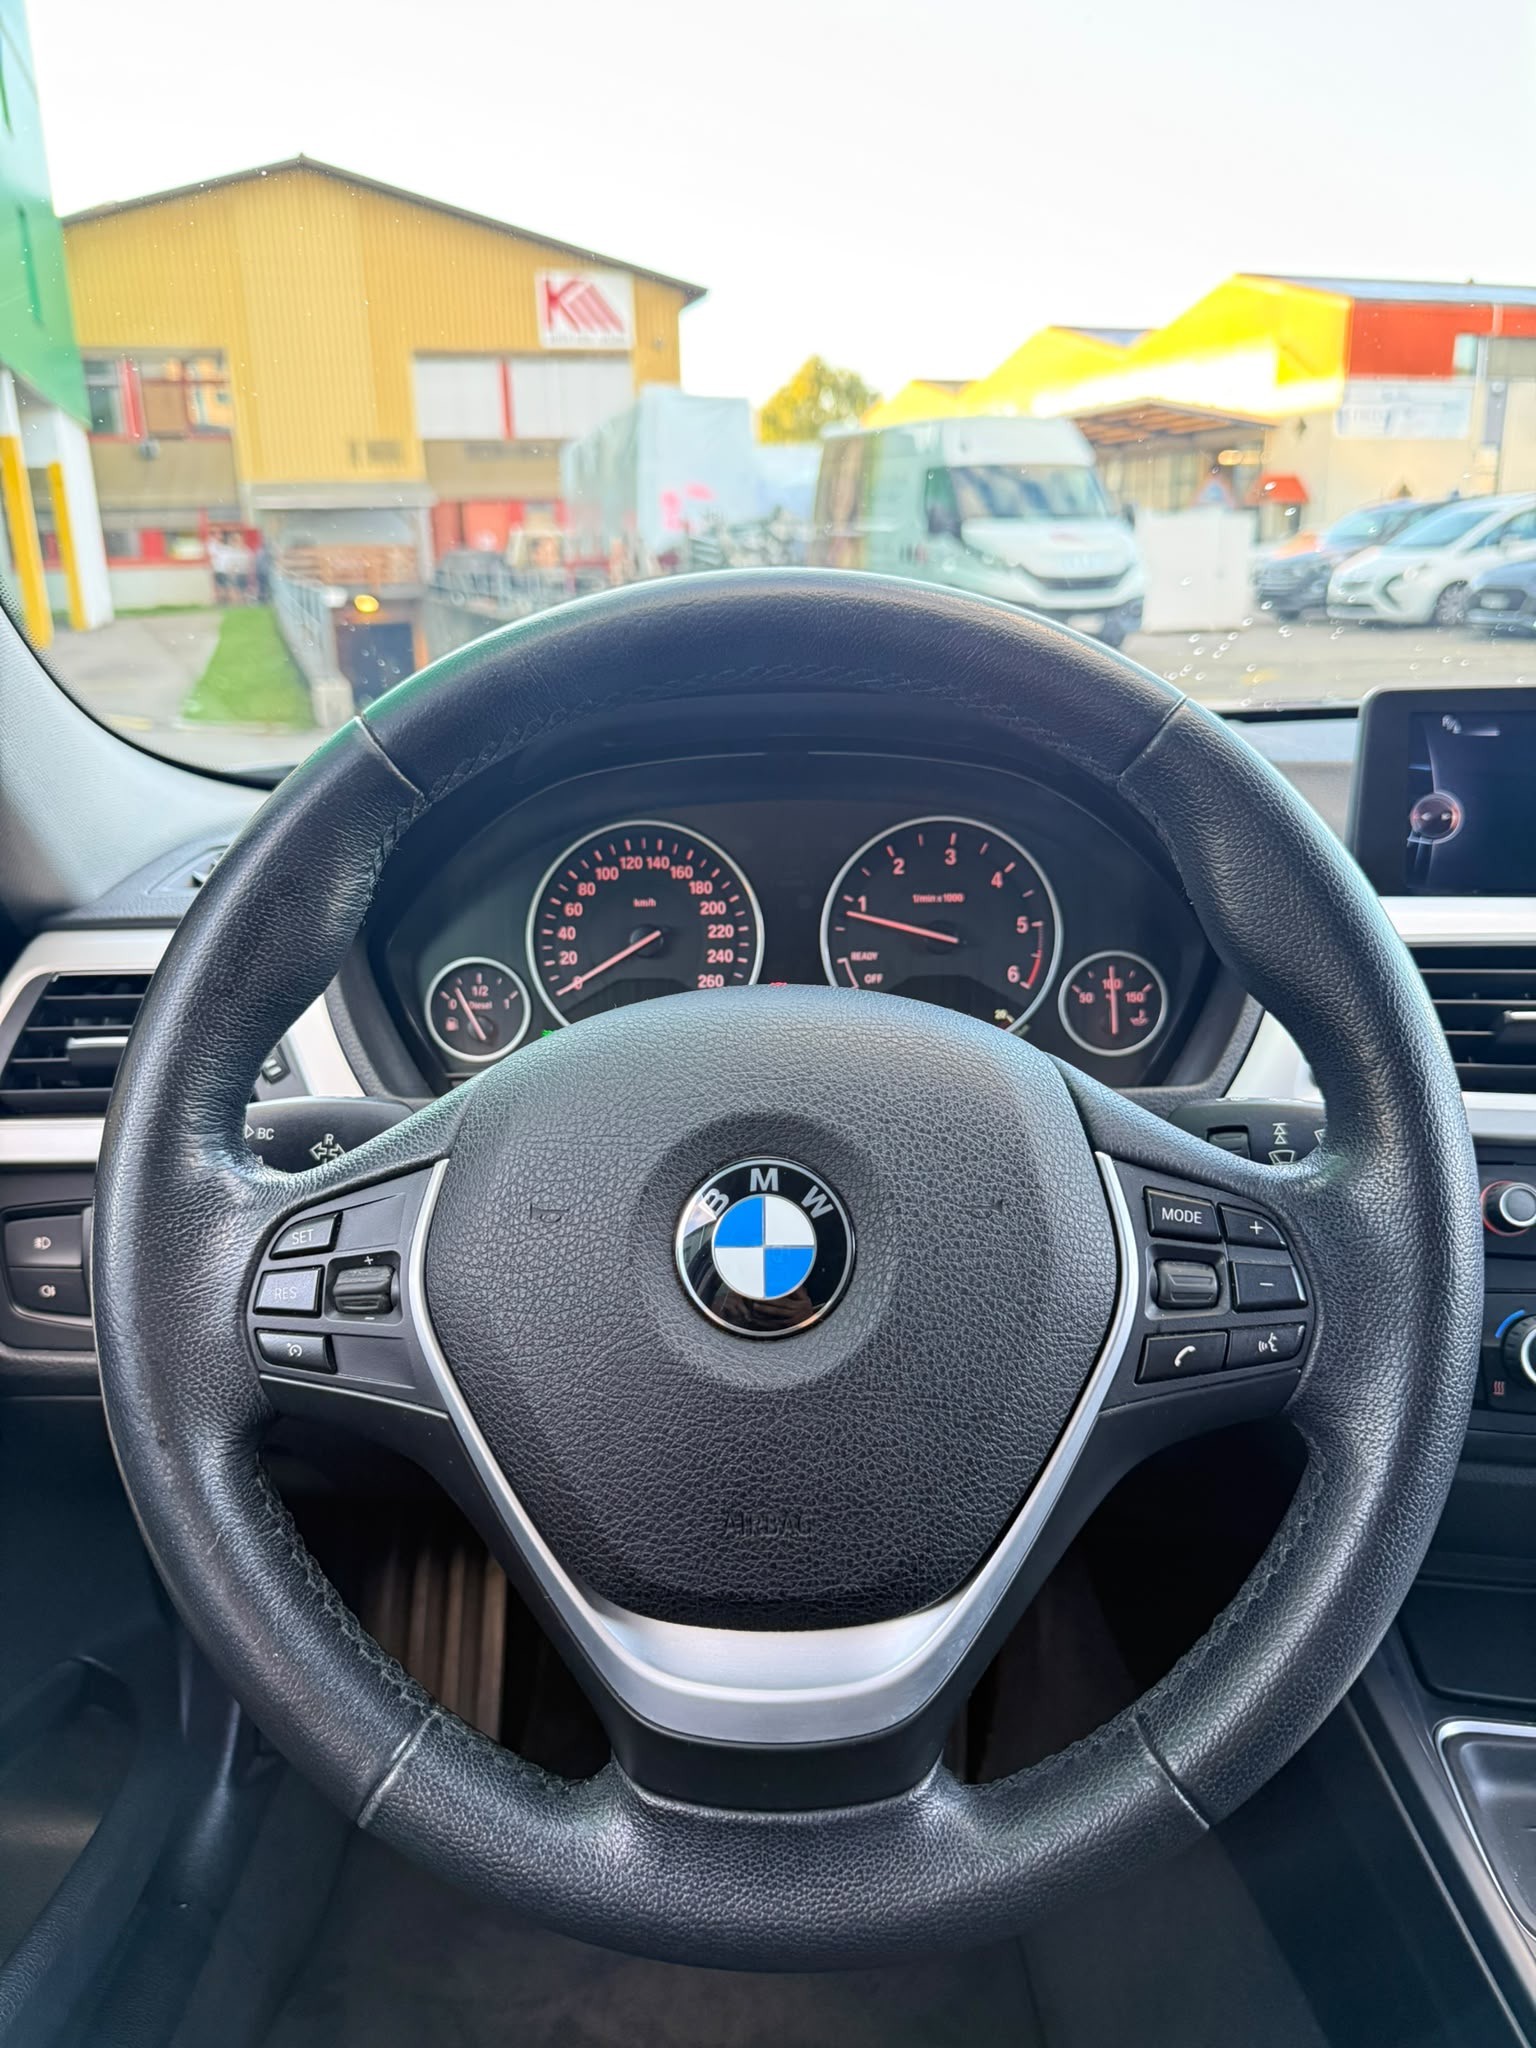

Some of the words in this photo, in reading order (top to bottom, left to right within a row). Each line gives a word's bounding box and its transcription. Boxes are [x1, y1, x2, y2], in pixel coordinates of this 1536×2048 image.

[619, 856, 643, 870] 120
[647, 856, 670, 870] 140
[945, 850, 957, 865] 3
[595, 867, 619, 881] 100
[670, 866, 693, 880] 160
[893, 859, 905, 875] 2
[991, 872, 1003, 888] 4
[577, 882, 596, 897] 80
[689, 881, 713, 896] 180
[564, 902, 583, 917] 60
[700, 901, 726, 915] 200
[858, 896, 867, 912] 1
[708, 924, 734, 939] 220
[1016, 917, 1028, 933] 5
[557, 927, 576, 942] 40
[560, 950, 577, 965] 20
[707, 949, 733, 964] 240
[851, 951, 878, 961] READY
[698, 974, 724, 989] 260
[864, 973, 883, 984] OFF
[1007, 966, 1019, 982] 6
[573, 976, 583, 990] 0
[1102, 979, 1122, 990] 100
[472, 985, 488, 997] 1/2
[1079, 992, 1094, 1004] 50
[1125, 992, 1145, 1003] 150
[448, 999, 457, 1010] 0
[503, 999, 510, 1009] 1
[257, 1127, 275, 1140] BC
[324, 1133, 334, 1145] R
[701, 1168, 834, 1219] BMW
[1161, 1207, 1202, 1224] MODE
[292, 1229, 313, 1244] SET
[274, 1285, 297, 1300] RES
